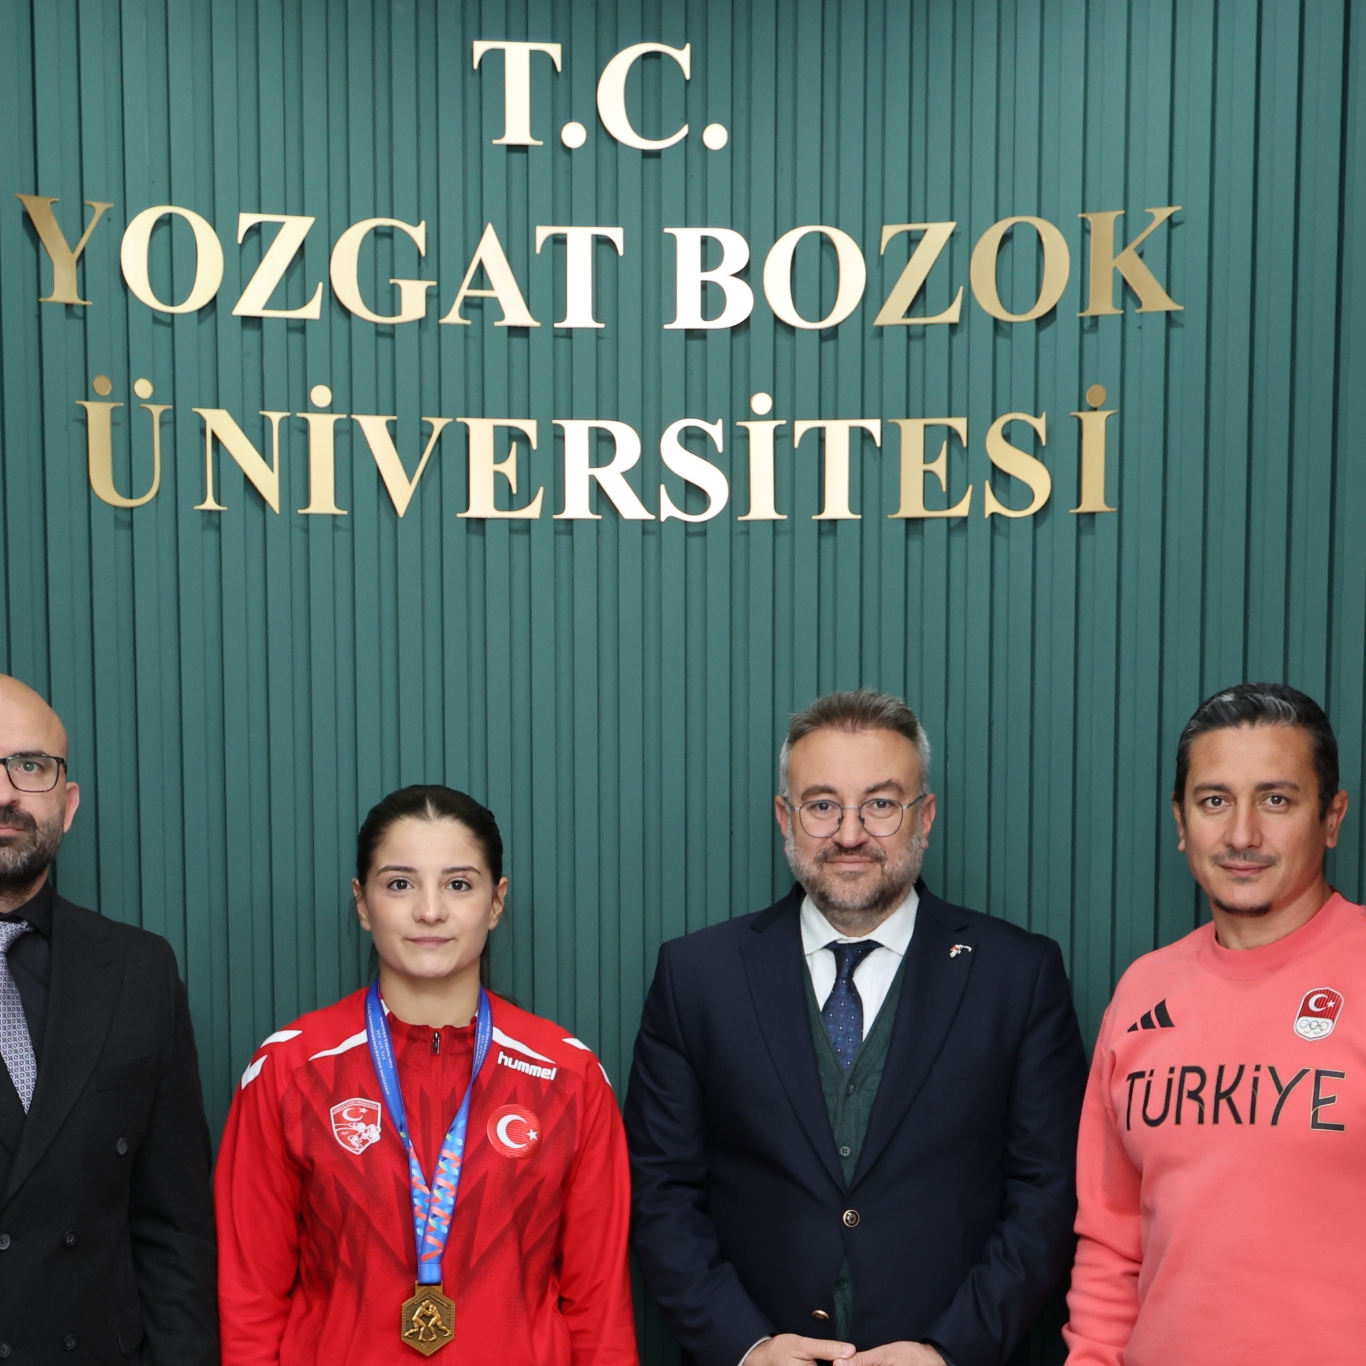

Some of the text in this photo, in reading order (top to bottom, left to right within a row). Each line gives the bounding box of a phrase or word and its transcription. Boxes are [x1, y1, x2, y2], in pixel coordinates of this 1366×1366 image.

[472, 39, 729, 151] T.C.
[14, 193, 1184, 330] YOZGAT BOZOK
[75, 374, 1118, 524] ÜNİVERSİTESİ
[497, 1050, 557, 1081] hummel
[1126, 1063, 1346, 1132] TÜRKİYE
